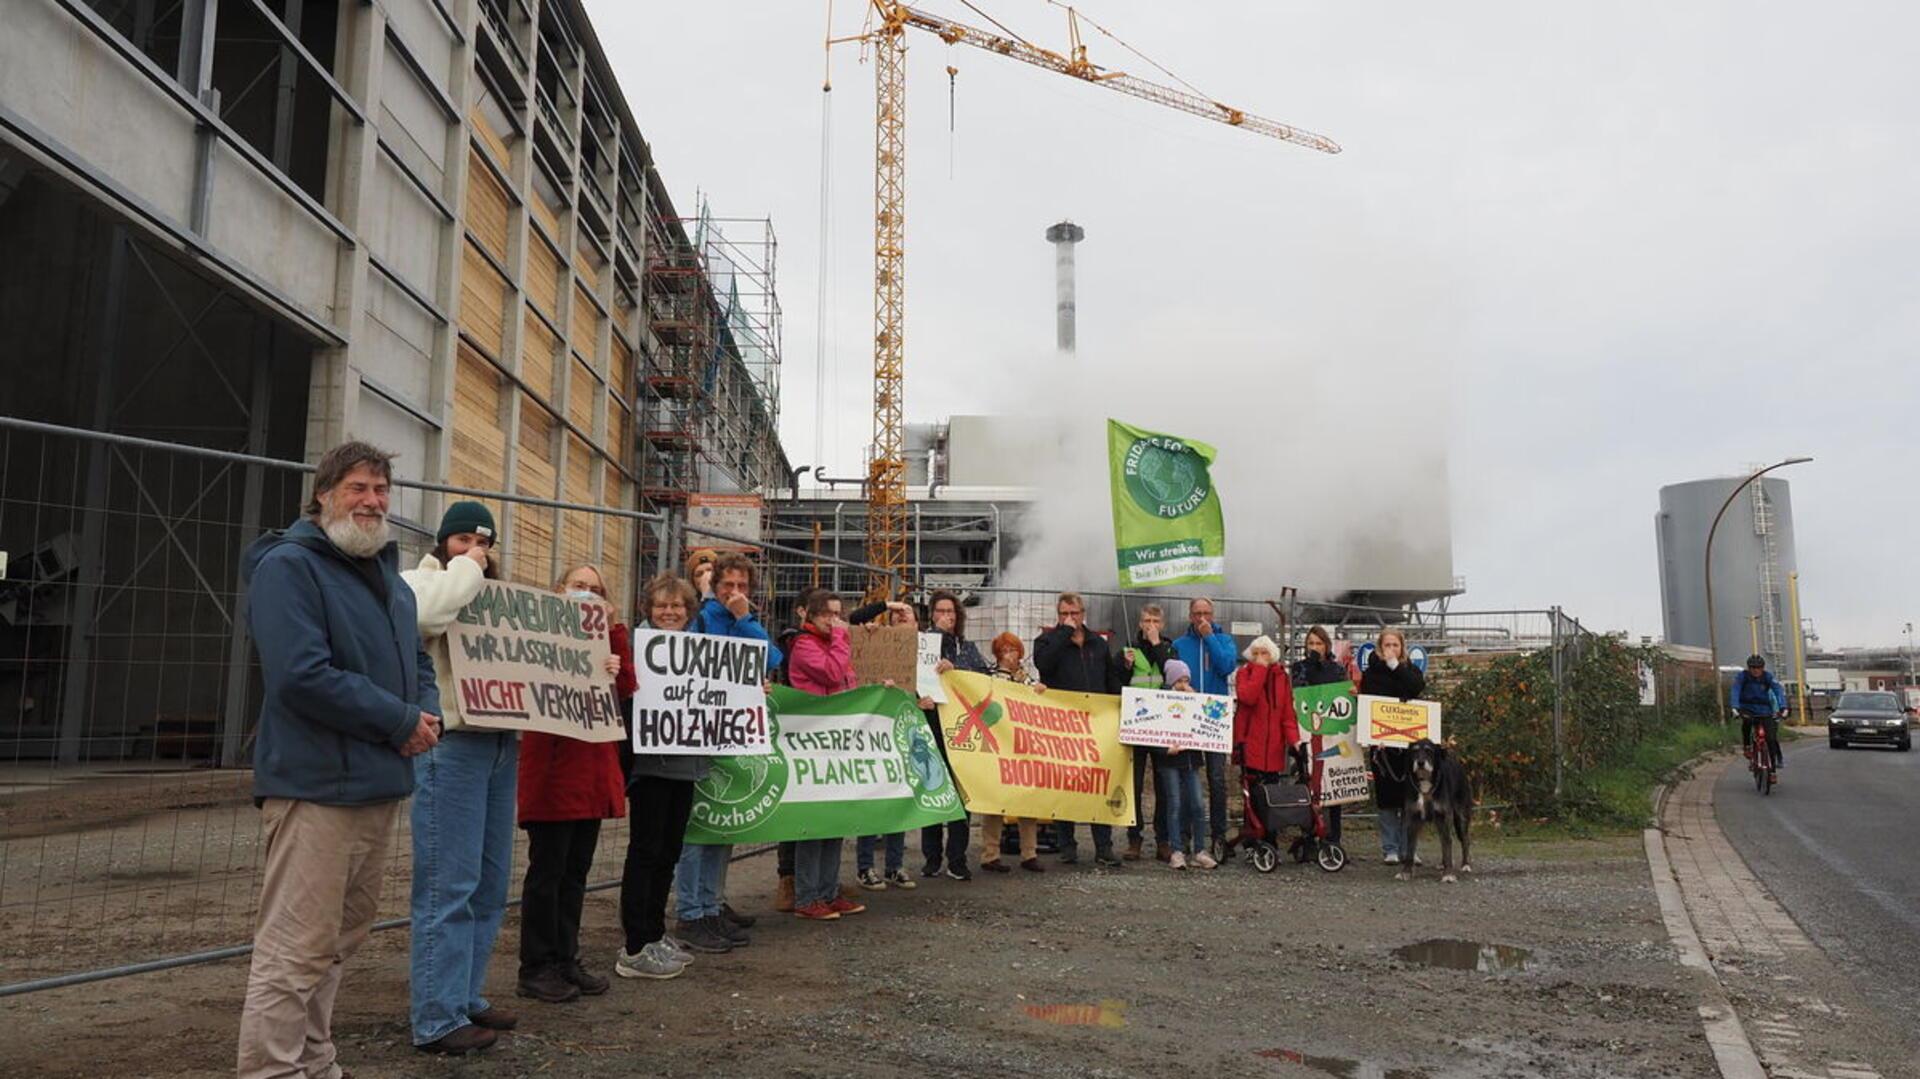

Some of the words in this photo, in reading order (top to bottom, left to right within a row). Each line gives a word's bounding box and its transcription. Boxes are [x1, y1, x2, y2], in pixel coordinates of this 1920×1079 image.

[1159, 487, 1207, 517] FUTURE
[1135, 548, 1156, 560] Wir
[461, 632, 503, 662] WIR
[503, 636, 561, 671] LASSEN
[559, 646, 593, 678] UNS
[645, 634, 767, 687] CUXHAVEN
[461, 678, 526, 711] NICHT
[529, 682, 623, 730] VERKOHLEN!
[663, 678, 695, 707] auf
[698, 680, 727, 706] dem
[1004, 697, 1092, 734] BIOENERGY
[1328, 702, 1350, 718] AU
[640, 706, 765, 748] HOLZWEG?!
[784, 729, 865, 752] THERE'S
[869, 732, 892, 753] NO
[1014, 726, 1100, 763] DESTROYS
[793, 757, 877, 785] PLANET
[883, 758, 903, 785] B!
[998, 757, 1111, 796] BIODIVERSITY
[1331, 775, 1365, 788] retten
[693, 784, 780, 827] Cuxhaven
[1333, 786, 1369, 800] Klima
